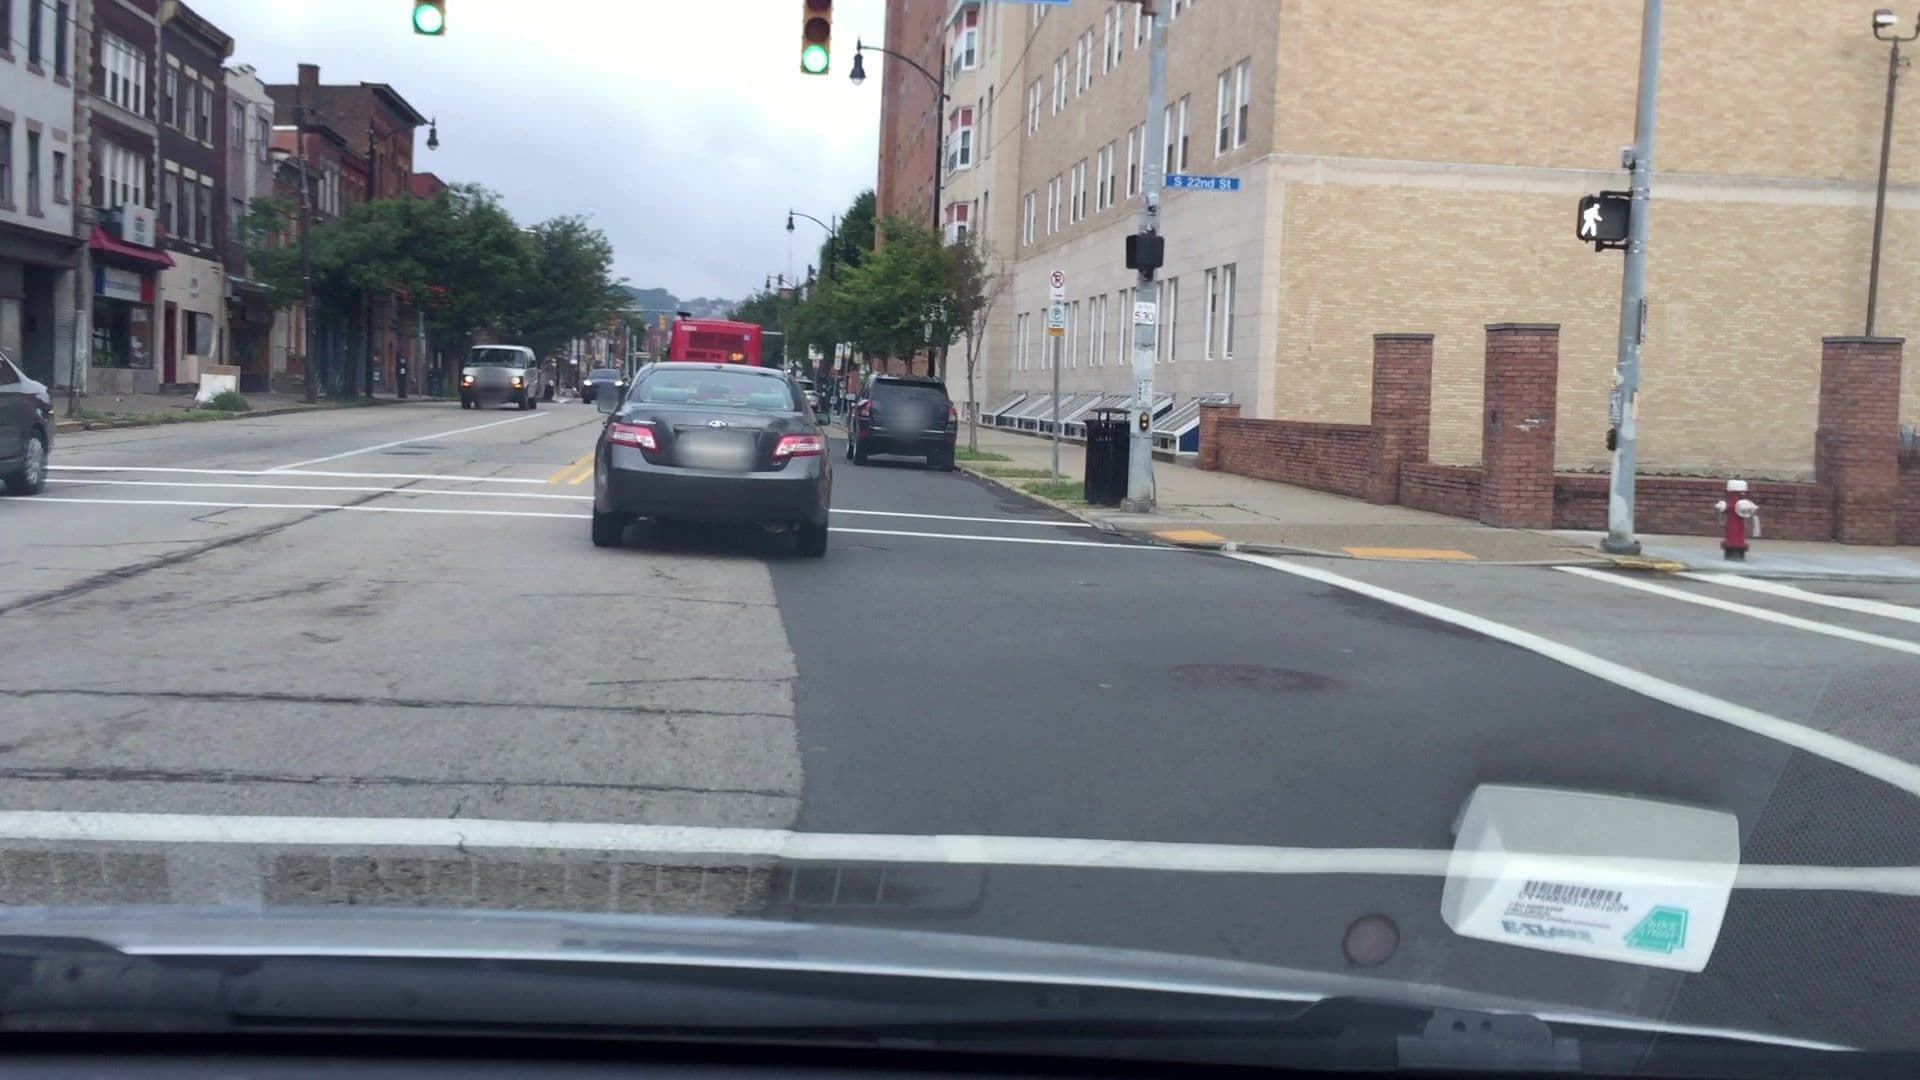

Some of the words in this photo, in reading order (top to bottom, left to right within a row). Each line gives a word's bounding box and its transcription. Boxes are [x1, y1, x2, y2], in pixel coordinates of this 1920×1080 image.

[1174, 176, 1183, 187] S
[1187, 177, 1216, 188] 22nd
[1219, 178, 1232, 190] St
